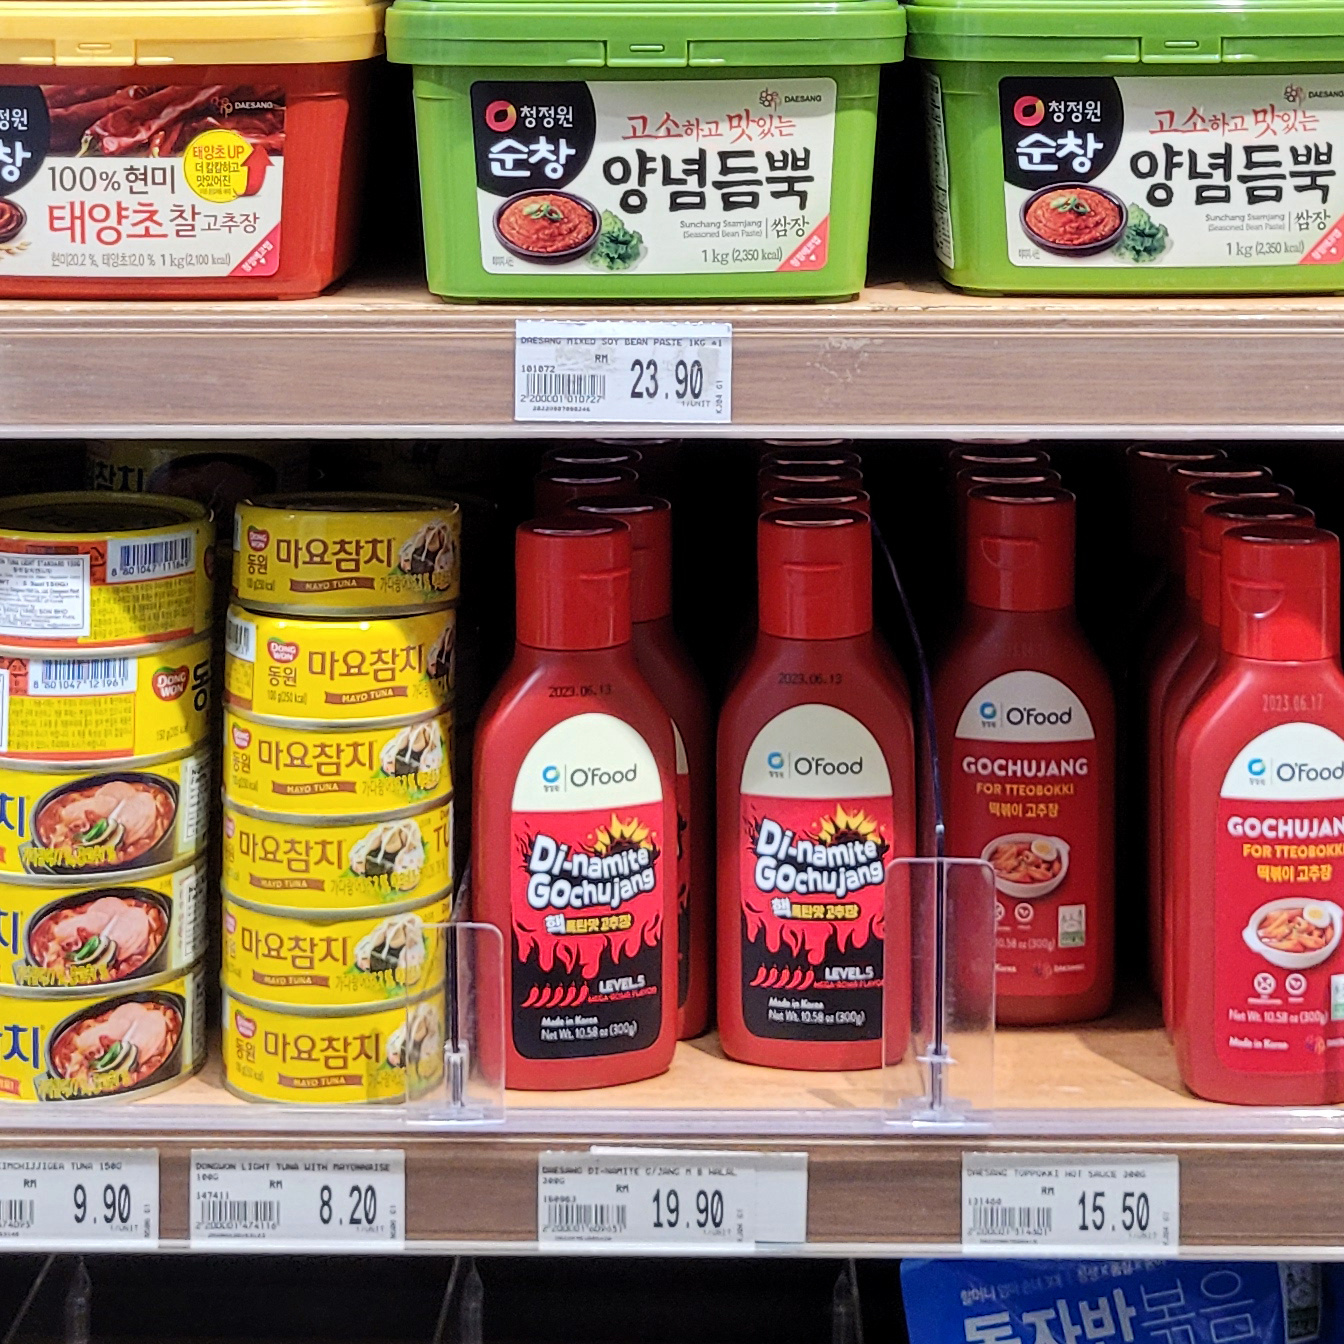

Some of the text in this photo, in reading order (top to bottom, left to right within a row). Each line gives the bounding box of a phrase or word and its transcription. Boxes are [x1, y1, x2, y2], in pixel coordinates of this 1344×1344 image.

[234, 101, 274, 110] DAESANG
[520, 103, 574, 128] 청정원
[783, 93, 822, 103] DAESANG
[621, 107, 798, 144] 고소하고 맛있는
[1015, 130, 1105, 173] 순창
[602, 147, 815, 213] 양념듬뿍
[1130, 140, 1337, 207] 양념듬뿍
[770, 215, 810, 239] 쌈장
[629, 359, 704, 400] 23.90
[275, 537, 394, 574] 마요참치
[308, 643, 424, 683] 마요참치
[1006, 706, 1072, 726] O'Food
[569, 763, 638, 788] O'Food
[961, 755, 1089, 778] GOCHUJANG
[1242, 843, 1272, 858] FOR
[263, 1030, 381, 1070] 마요참치
[72, 1183, 132, 1225] 9.90
[319, 1183, 378, 1226] 8.20
[651, 1188, 725, 1229] 19.90
[1077, 1190, 1151, 1233] 15.50
